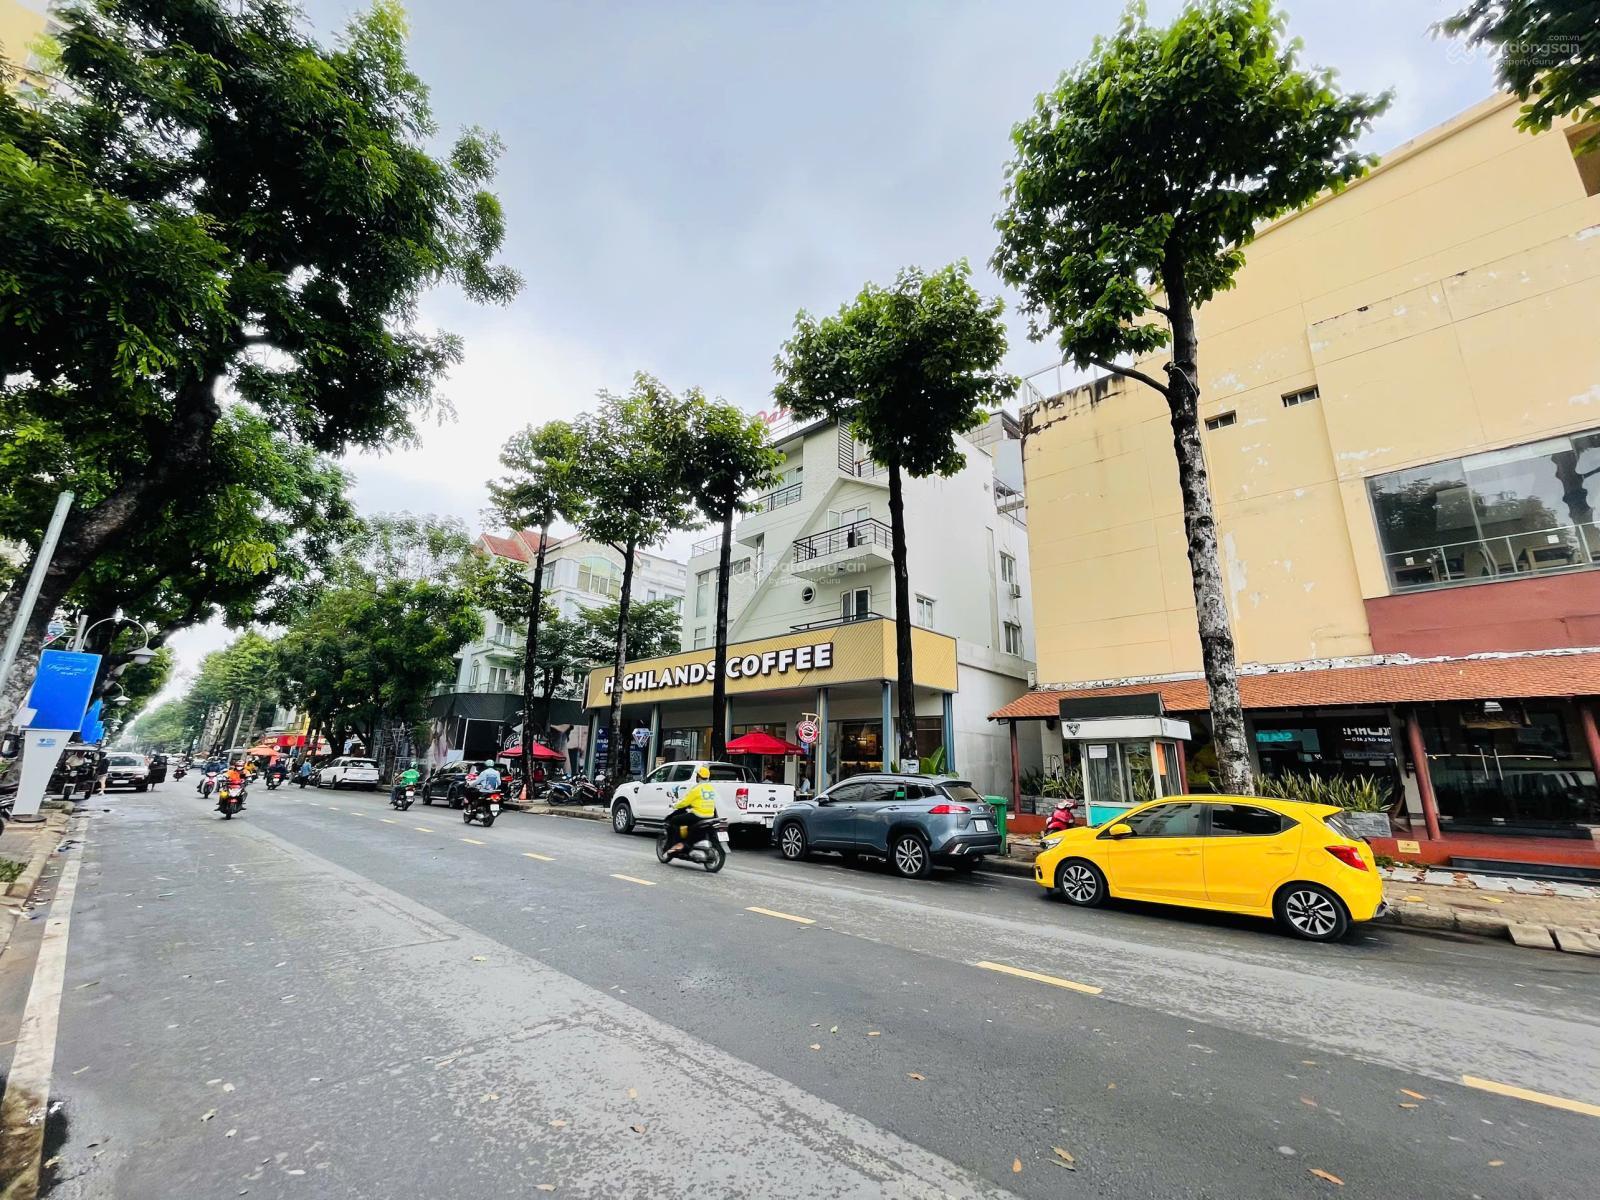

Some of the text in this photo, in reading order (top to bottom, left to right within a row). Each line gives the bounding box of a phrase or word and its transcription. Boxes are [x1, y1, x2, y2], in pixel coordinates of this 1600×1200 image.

[604, 642, 833, 694] HGHLANDS COFFEE
[701, 788, 716, 801] be
